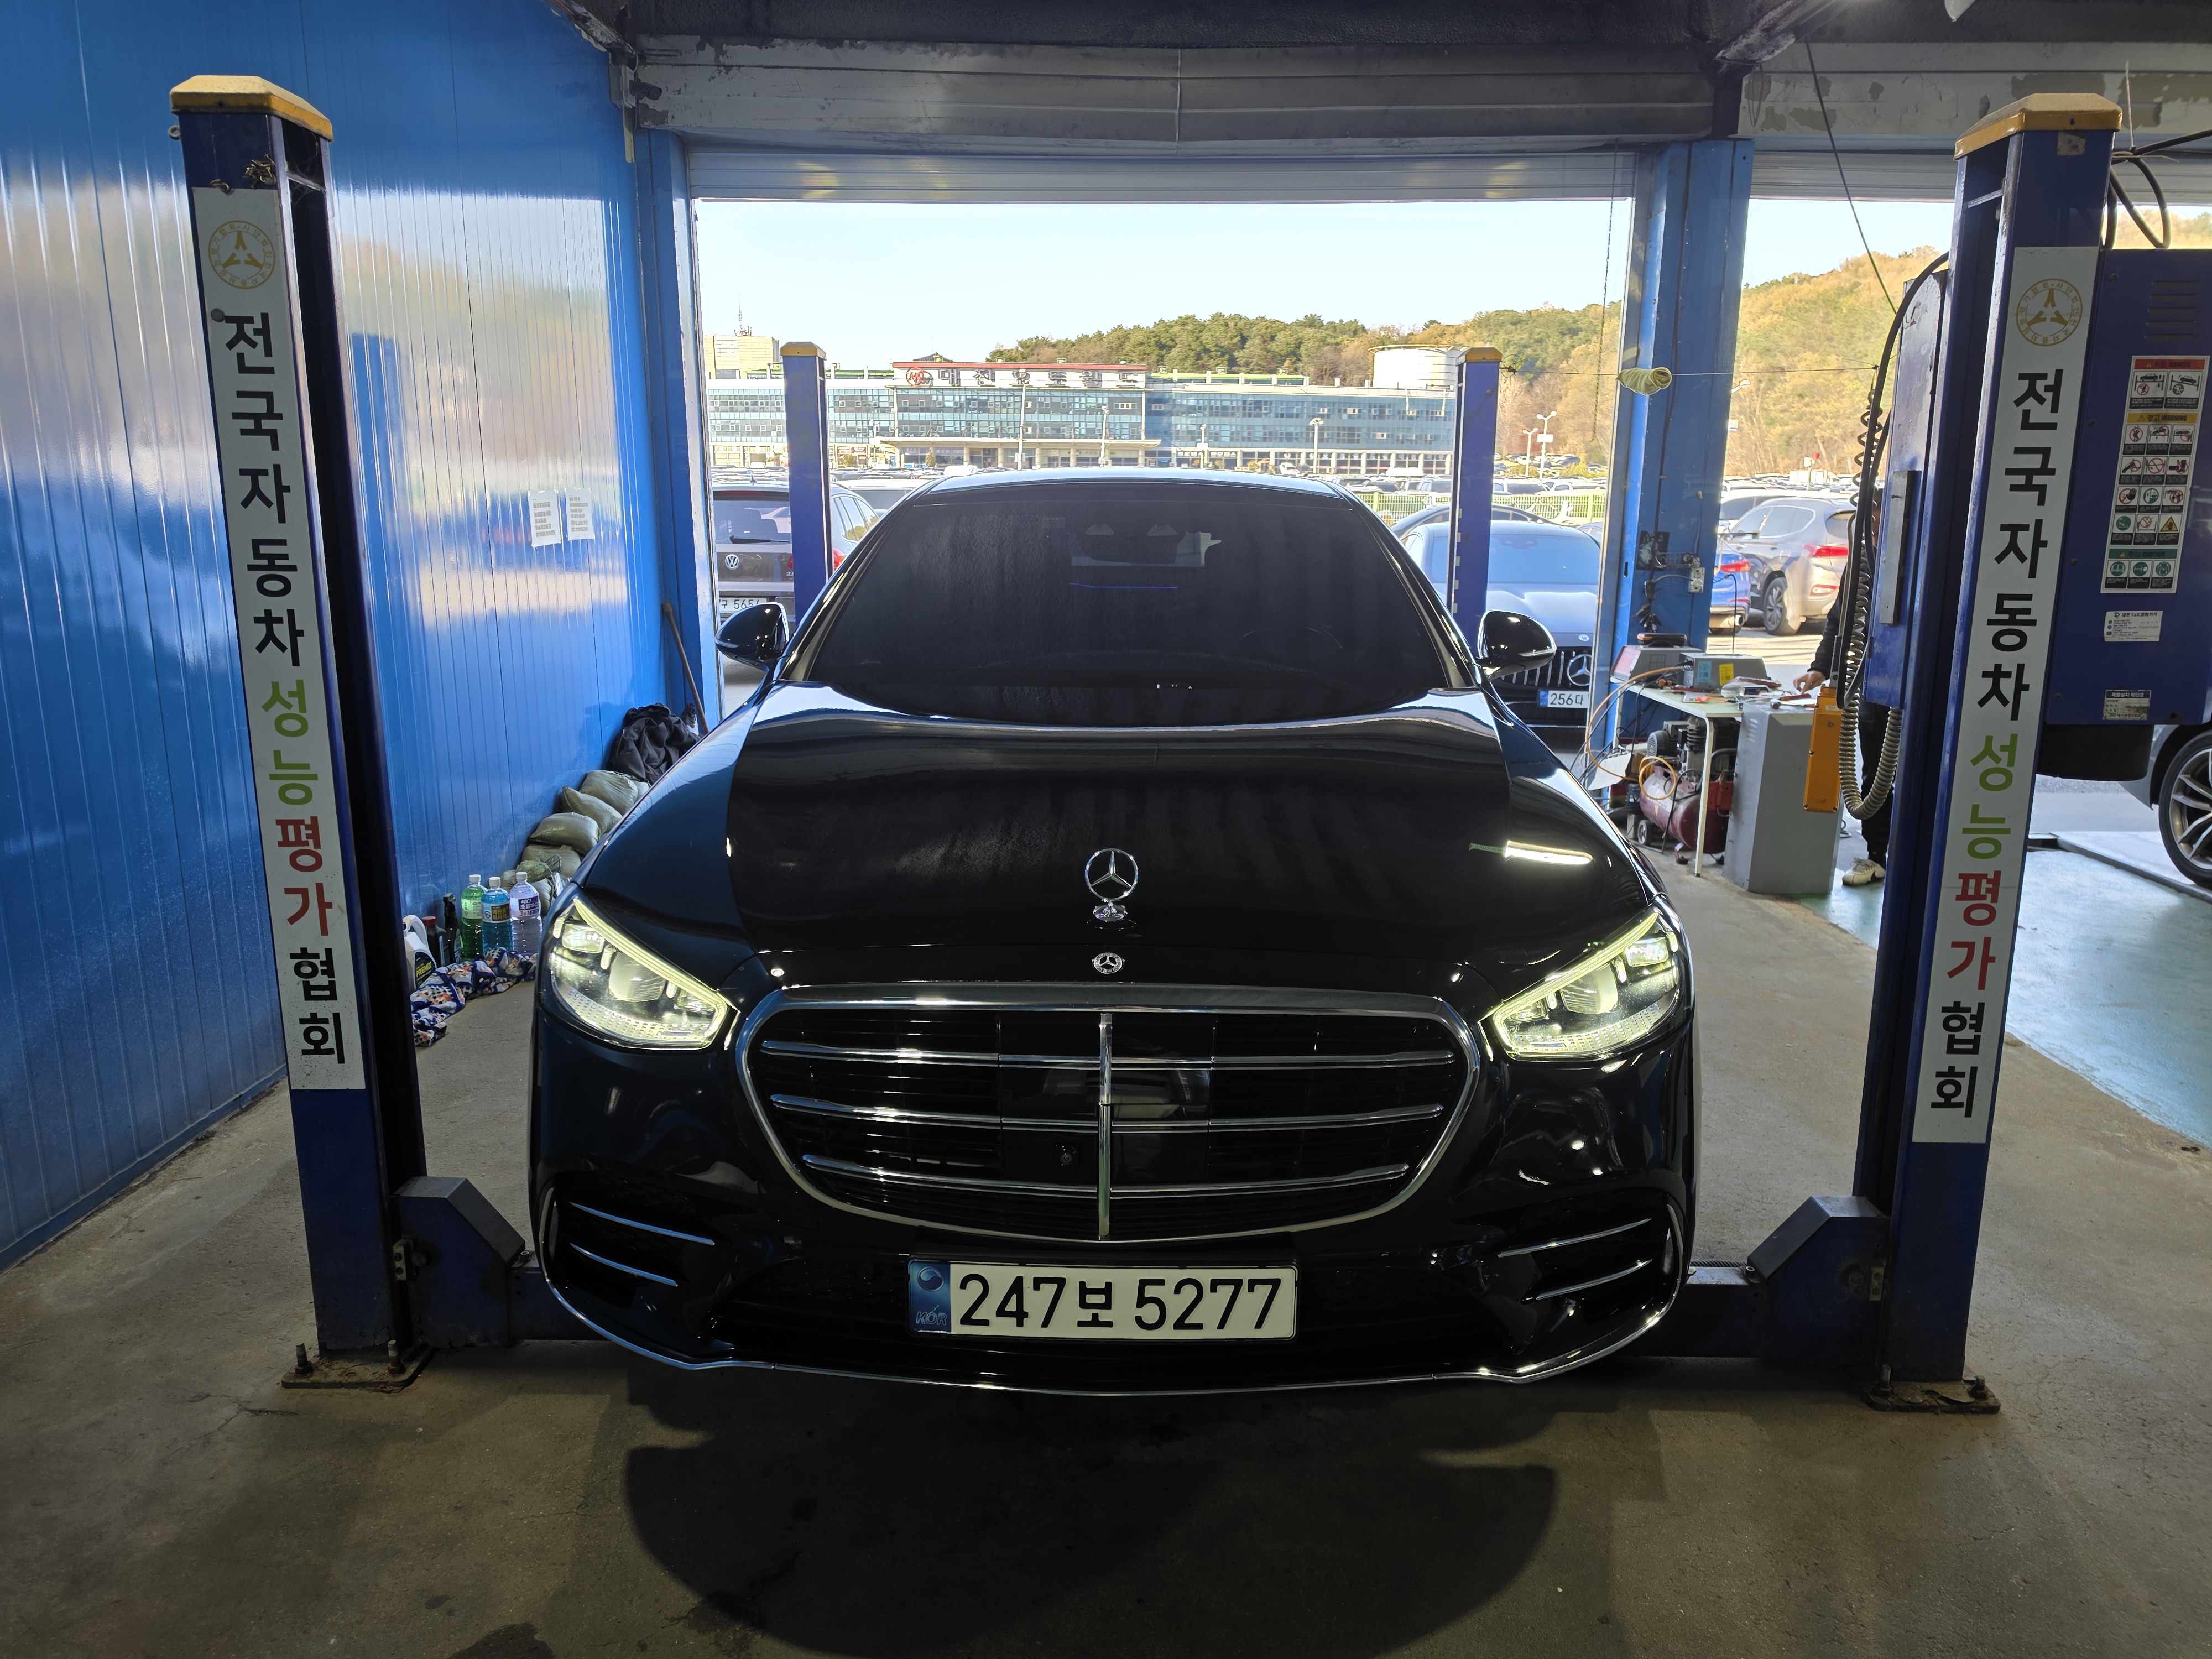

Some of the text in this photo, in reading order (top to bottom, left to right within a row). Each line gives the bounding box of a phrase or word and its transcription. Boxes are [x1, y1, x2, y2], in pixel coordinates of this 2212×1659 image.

[1550, 693, 1583, 706] 256다
[416, 961, 432, 978] PREMIX
[959, 1273, 1282, 1331] 247보 5277
[915, 1311, 948, 1326] KOR
